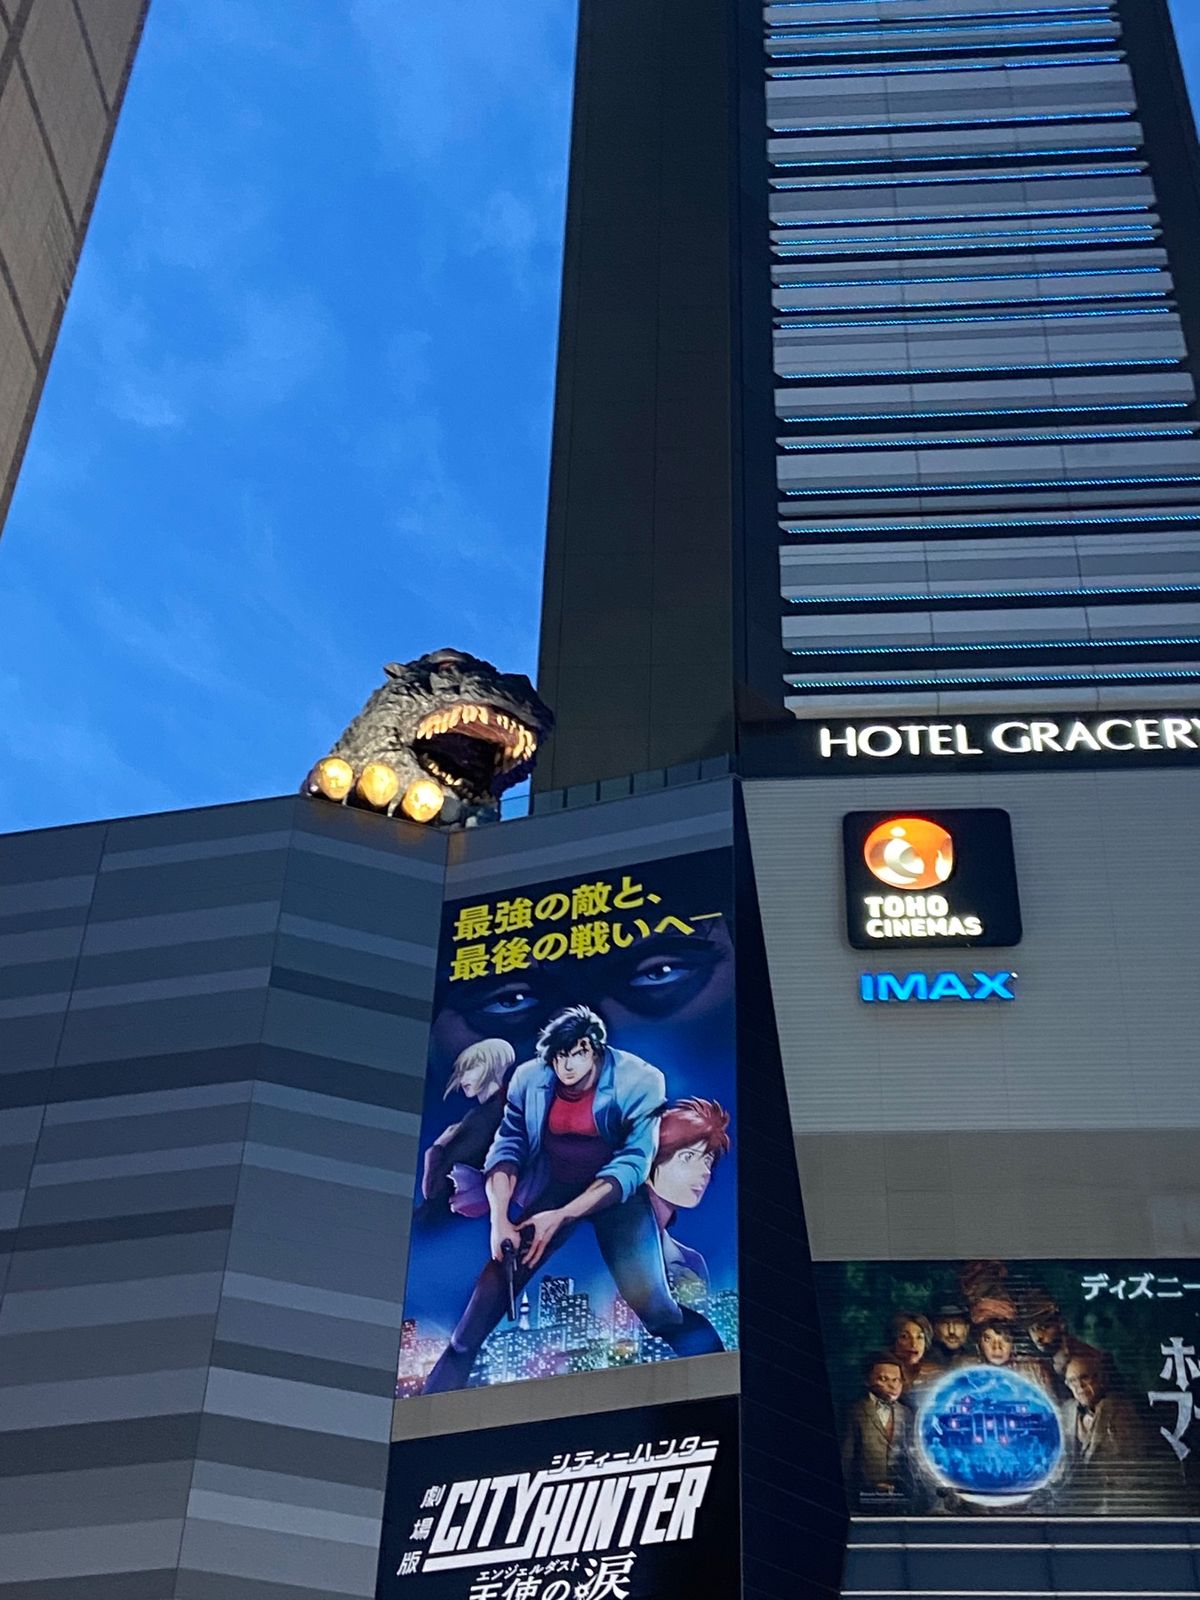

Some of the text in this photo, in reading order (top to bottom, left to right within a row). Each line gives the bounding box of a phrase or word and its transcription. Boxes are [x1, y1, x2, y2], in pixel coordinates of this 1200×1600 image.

[819, 724, 984, 757] HOTEL
[452, 876, 662, 942] 最強の敵と、
[863, 895, 949, 918] TOHO
[865, 916, 983, 938] CINEMAS
[860, 971, 1016, 1001] IMAX
[1147, 1391, 1200, 1461] マ
[550, 1436, 720, 1475] シティーハンター
[428, 1466, 712, 1558] CITY HUNTER
[476, 1557, 580, 1582] エンジェルダスト
